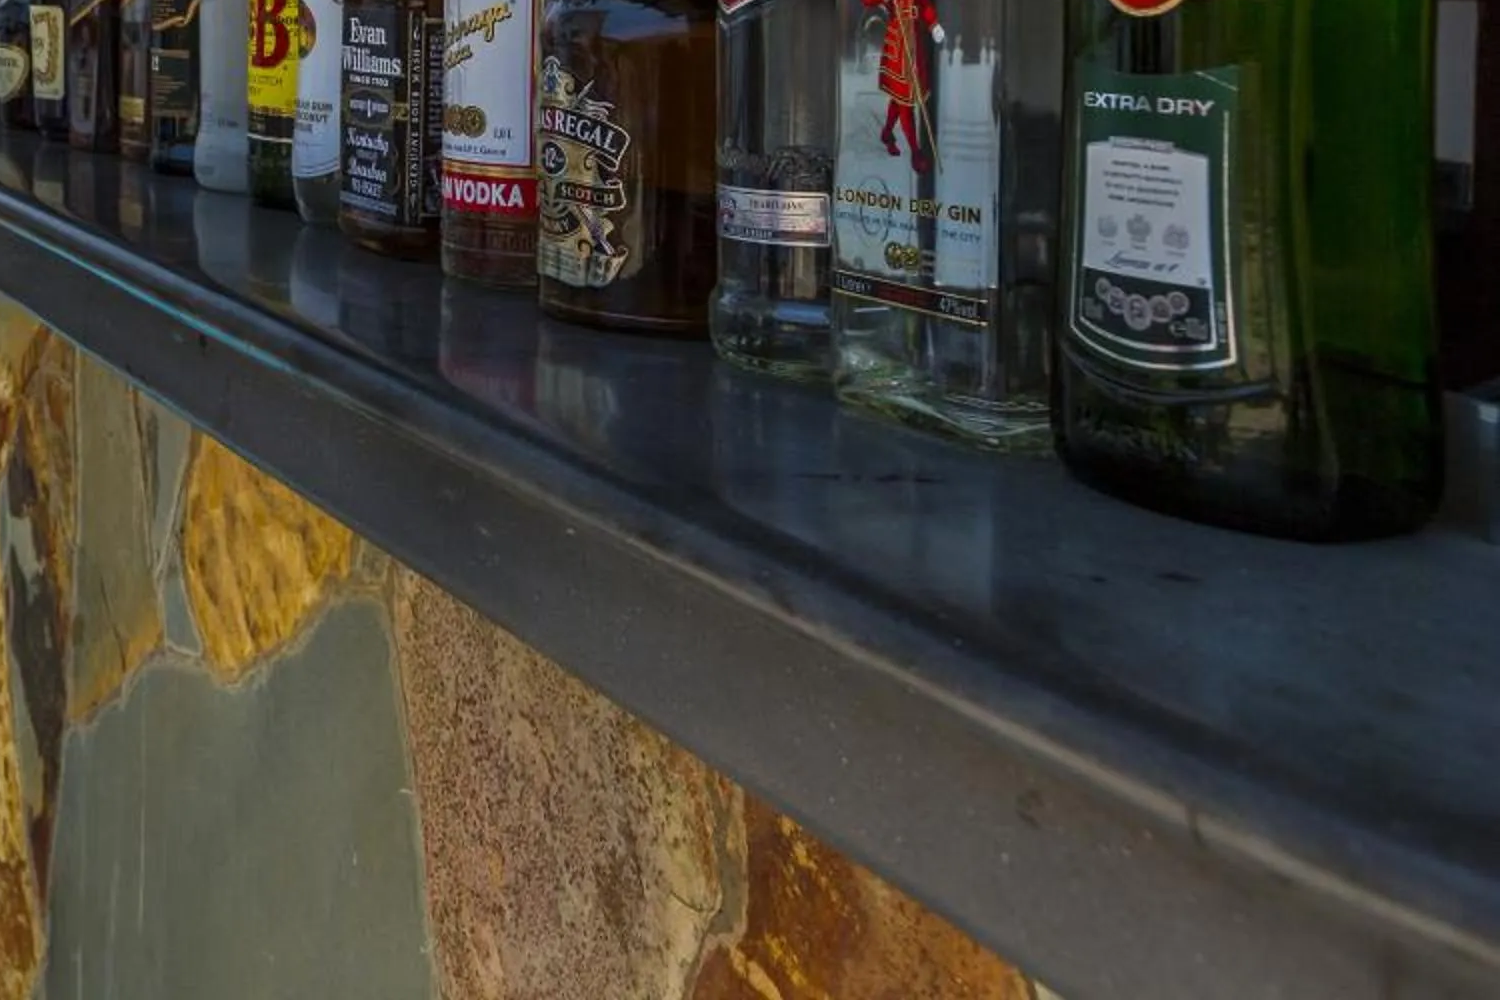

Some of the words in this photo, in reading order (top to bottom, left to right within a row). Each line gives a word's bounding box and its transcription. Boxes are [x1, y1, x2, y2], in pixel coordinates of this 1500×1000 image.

[348, 16, 388, 46] Evan
[342, 44, 402, 76] Williams
[1083, 91, 1151, 112] EXTRA
[1156, 96, 1215, 117] DRY
[555, 109, 617, 154] REGAL
[453, 178, 525, 208] VODKA
[561, 184, 615, 205] SCOTCH
[836, 187, 902, 211] LONDON
[909, 199, 943, 217] DRY
[947, 204, 981, 225] GIN
